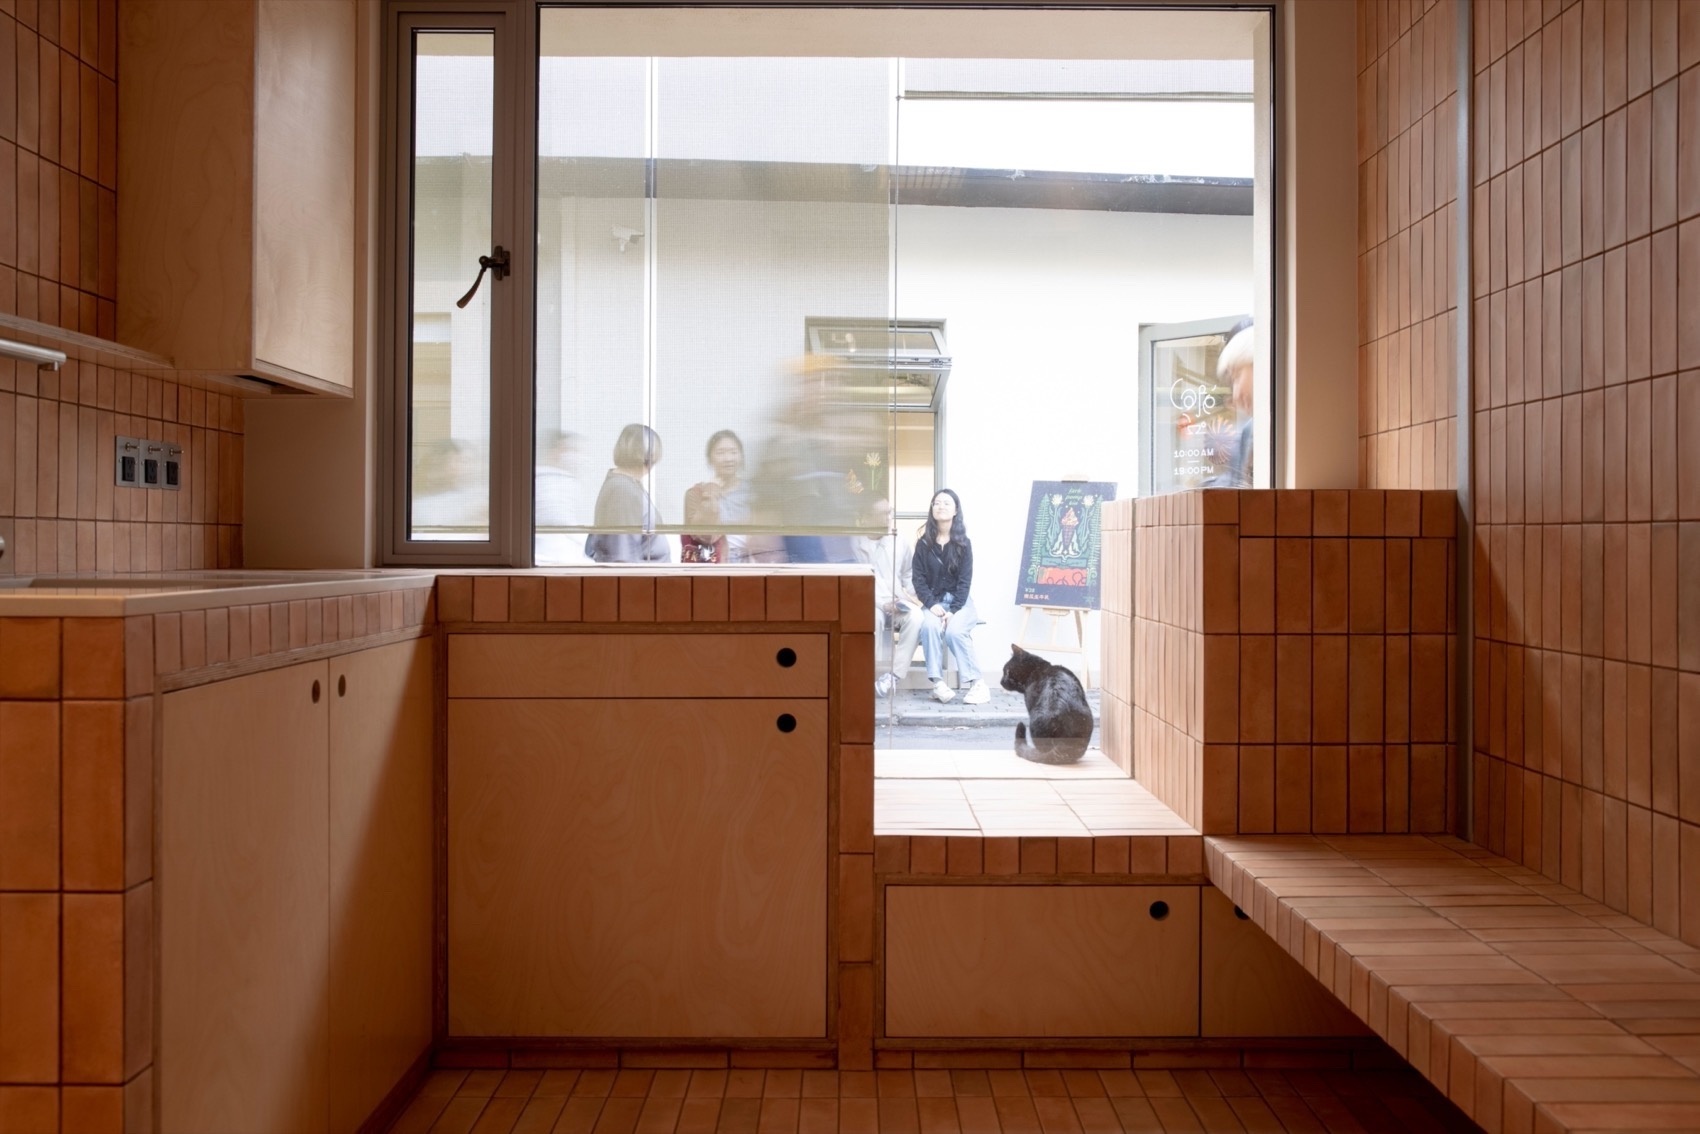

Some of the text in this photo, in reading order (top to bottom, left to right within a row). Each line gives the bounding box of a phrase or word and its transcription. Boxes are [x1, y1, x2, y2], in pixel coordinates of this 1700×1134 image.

[1174, 447, 1215, 458] 10:00 AM
[1200, 465, 1215, 474] PM
